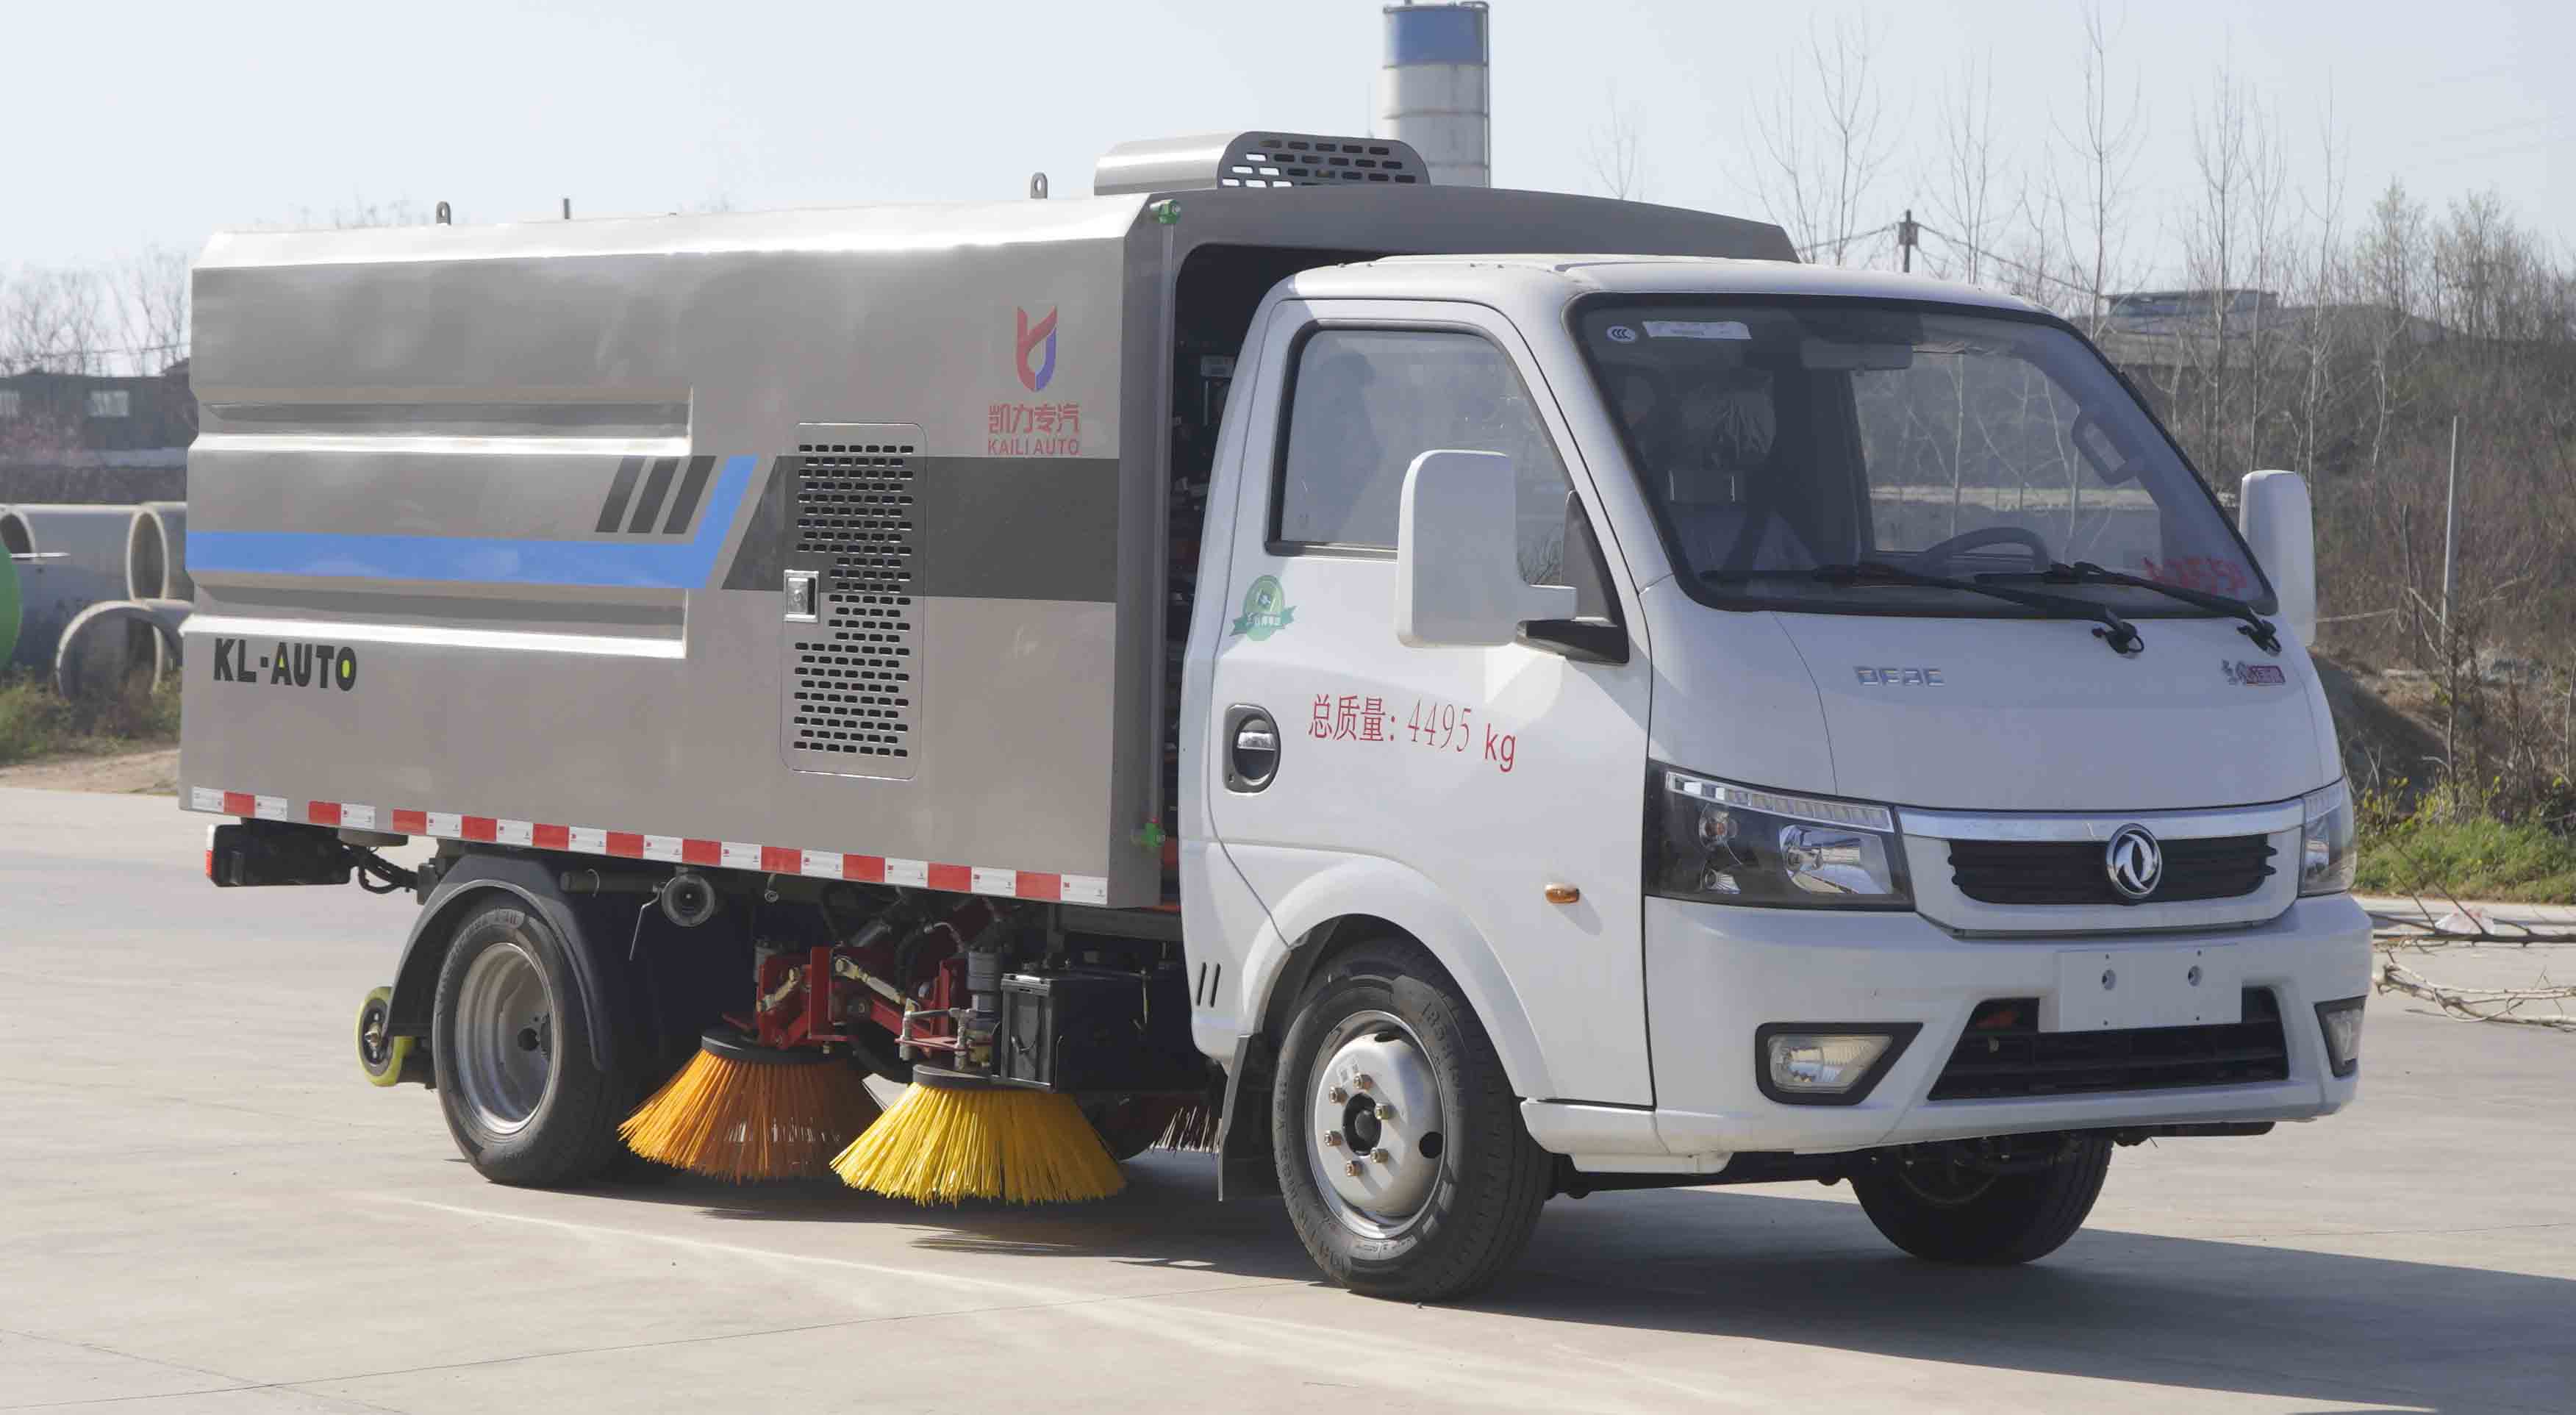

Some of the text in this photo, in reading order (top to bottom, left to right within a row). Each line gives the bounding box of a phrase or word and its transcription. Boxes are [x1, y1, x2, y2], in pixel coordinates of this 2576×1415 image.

[989, 404, 1081, 434] 凯力专汽
[988, 439, 1079, 455] KAILI AUTO
[213, 637, 357, 692] KL-AUTO
[1407, 699, 1473, 752] 4495
[1484, 723, 1516, 773] kg
